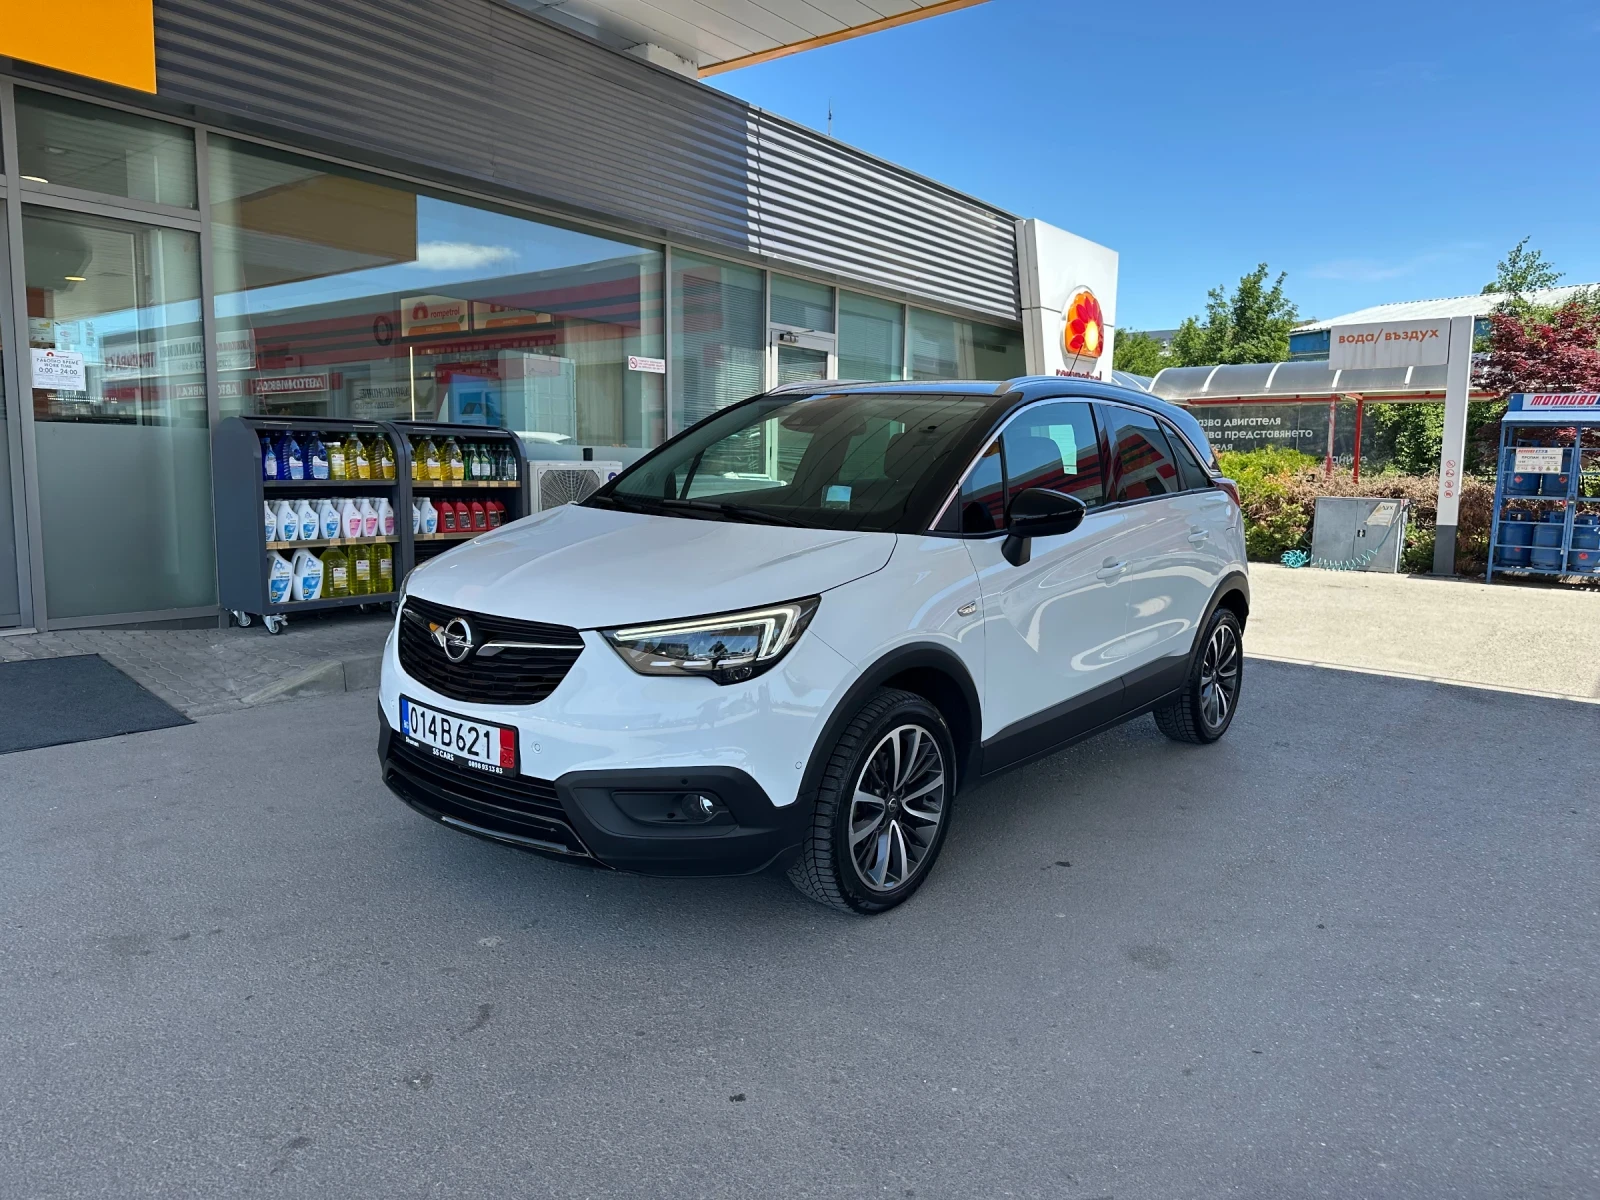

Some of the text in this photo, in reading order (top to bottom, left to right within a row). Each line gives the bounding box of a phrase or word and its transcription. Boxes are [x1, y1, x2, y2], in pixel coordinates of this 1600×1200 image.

[430, 306, 460, 319] rompetrol
[1384, 329, 1439, 343] въздух
[1223, 417, 1281, 427] двигателя
[1224, 429, 1313, 440] представянето
[410, 706, 490, 760] 014B621
[439, 751, 455, 762] CARS
